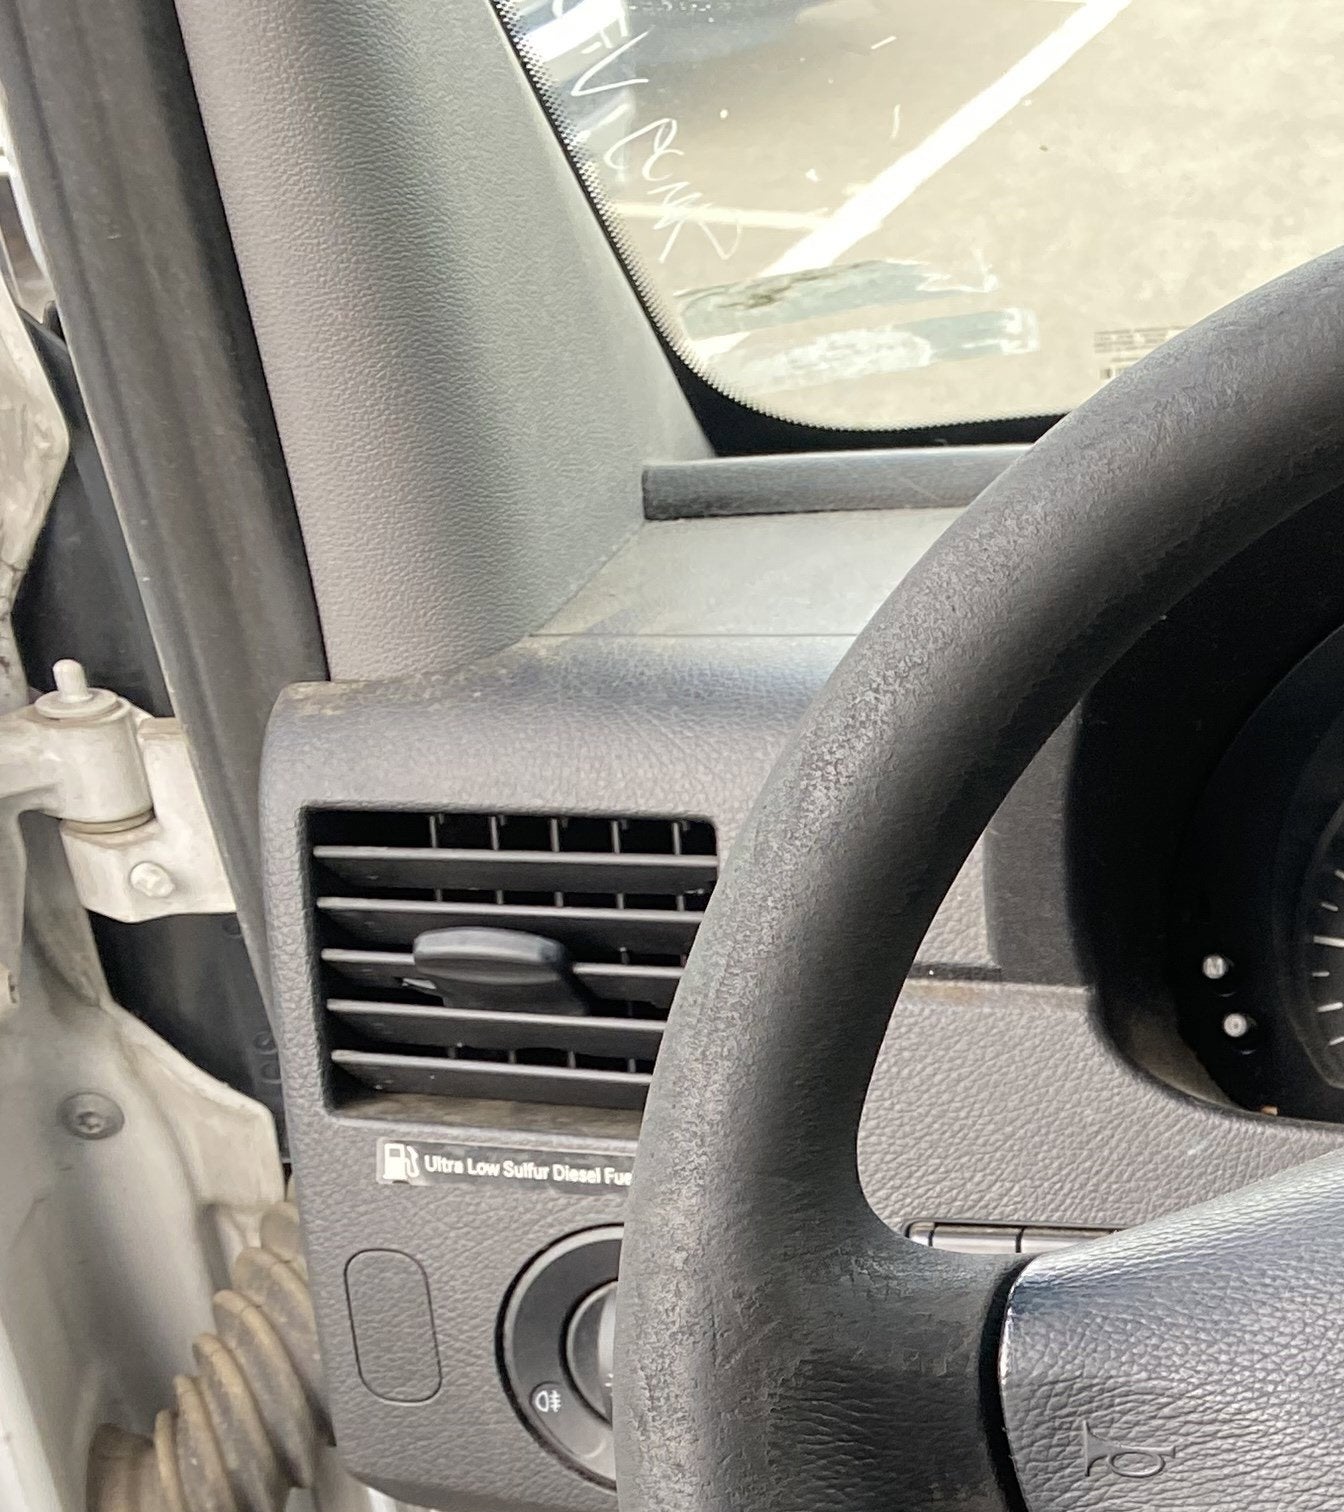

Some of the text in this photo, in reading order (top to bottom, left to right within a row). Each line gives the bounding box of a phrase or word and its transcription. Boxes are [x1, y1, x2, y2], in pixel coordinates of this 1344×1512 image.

[424, 1154, 465, 1175] Ultra
[467, 1158, 500, 1177] Low
[502, 1161, 550, 1181] Sulfur
[552, 1164, 602, 1184] Diesel
